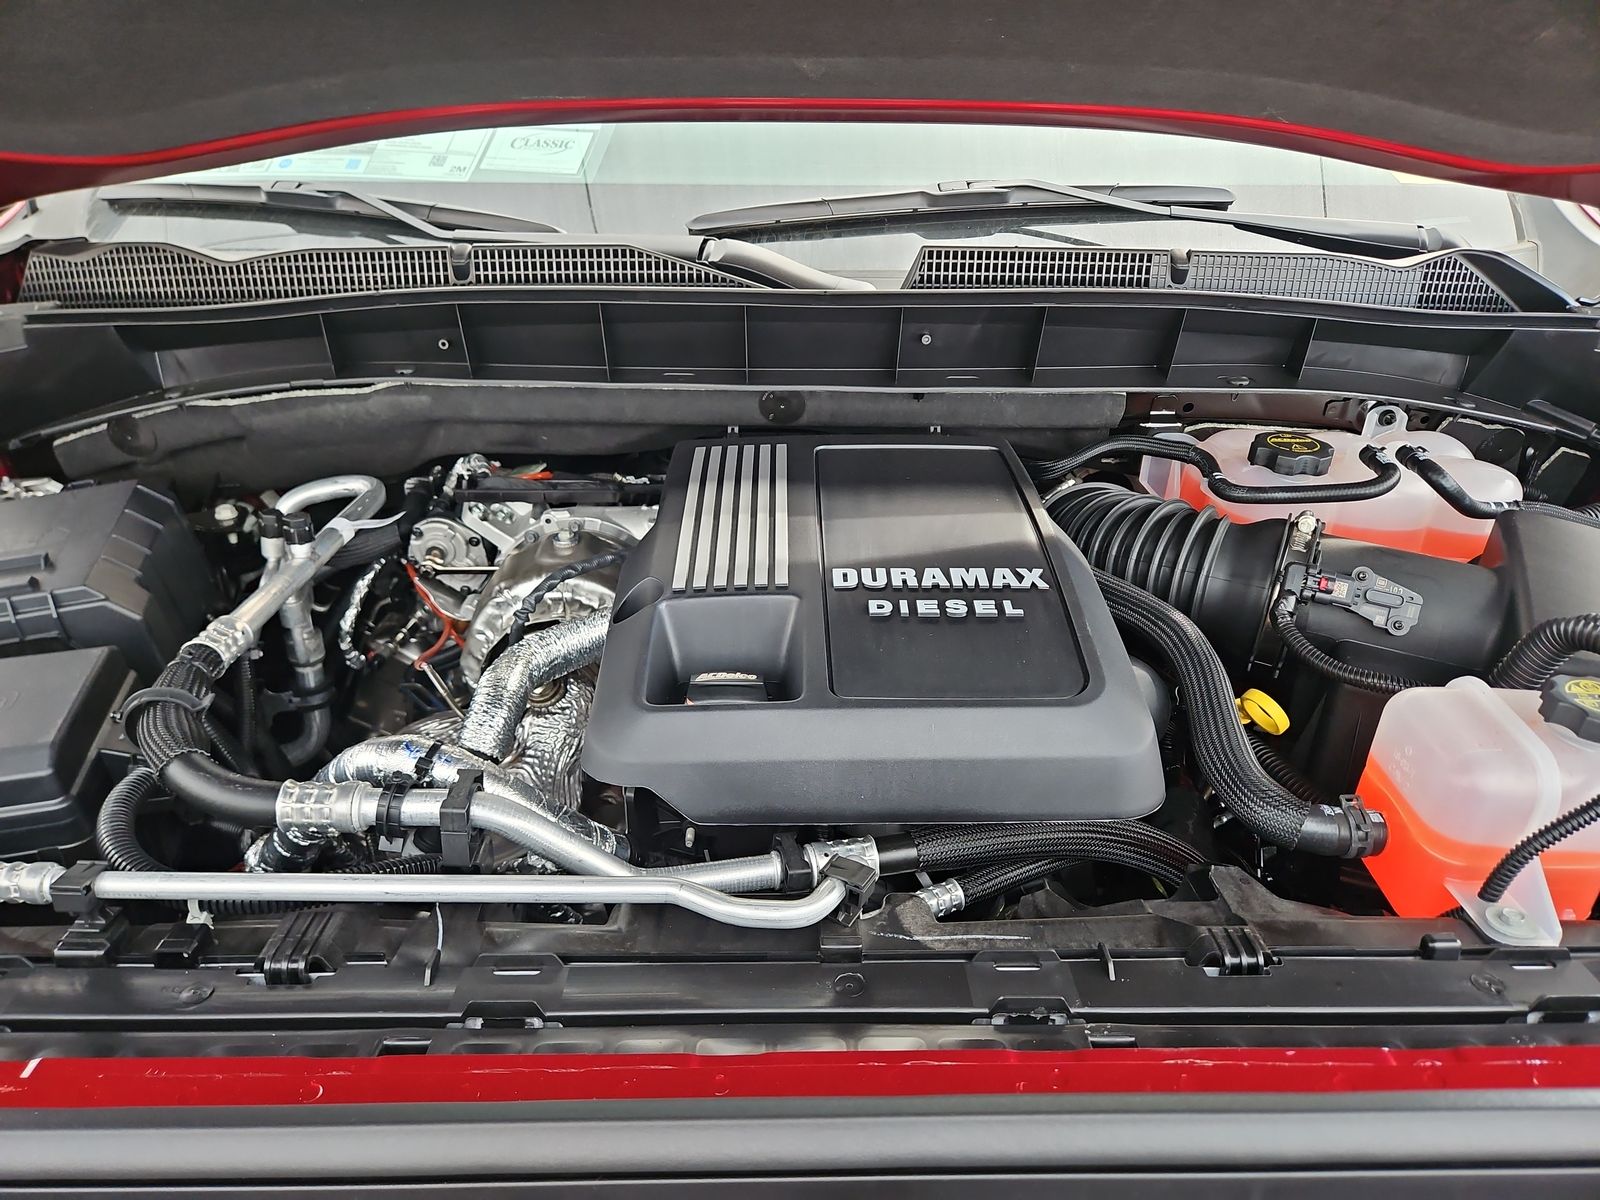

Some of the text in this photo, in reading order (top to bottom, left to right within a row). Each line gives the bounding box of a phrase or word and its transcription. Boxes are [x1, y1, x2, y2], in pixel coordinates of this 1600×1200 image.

[510, 136, 576, 150] CLASSIC
[832, 567, 1050, 590] DURAMAX
[868, 599, 1025, 618] DIESEL
